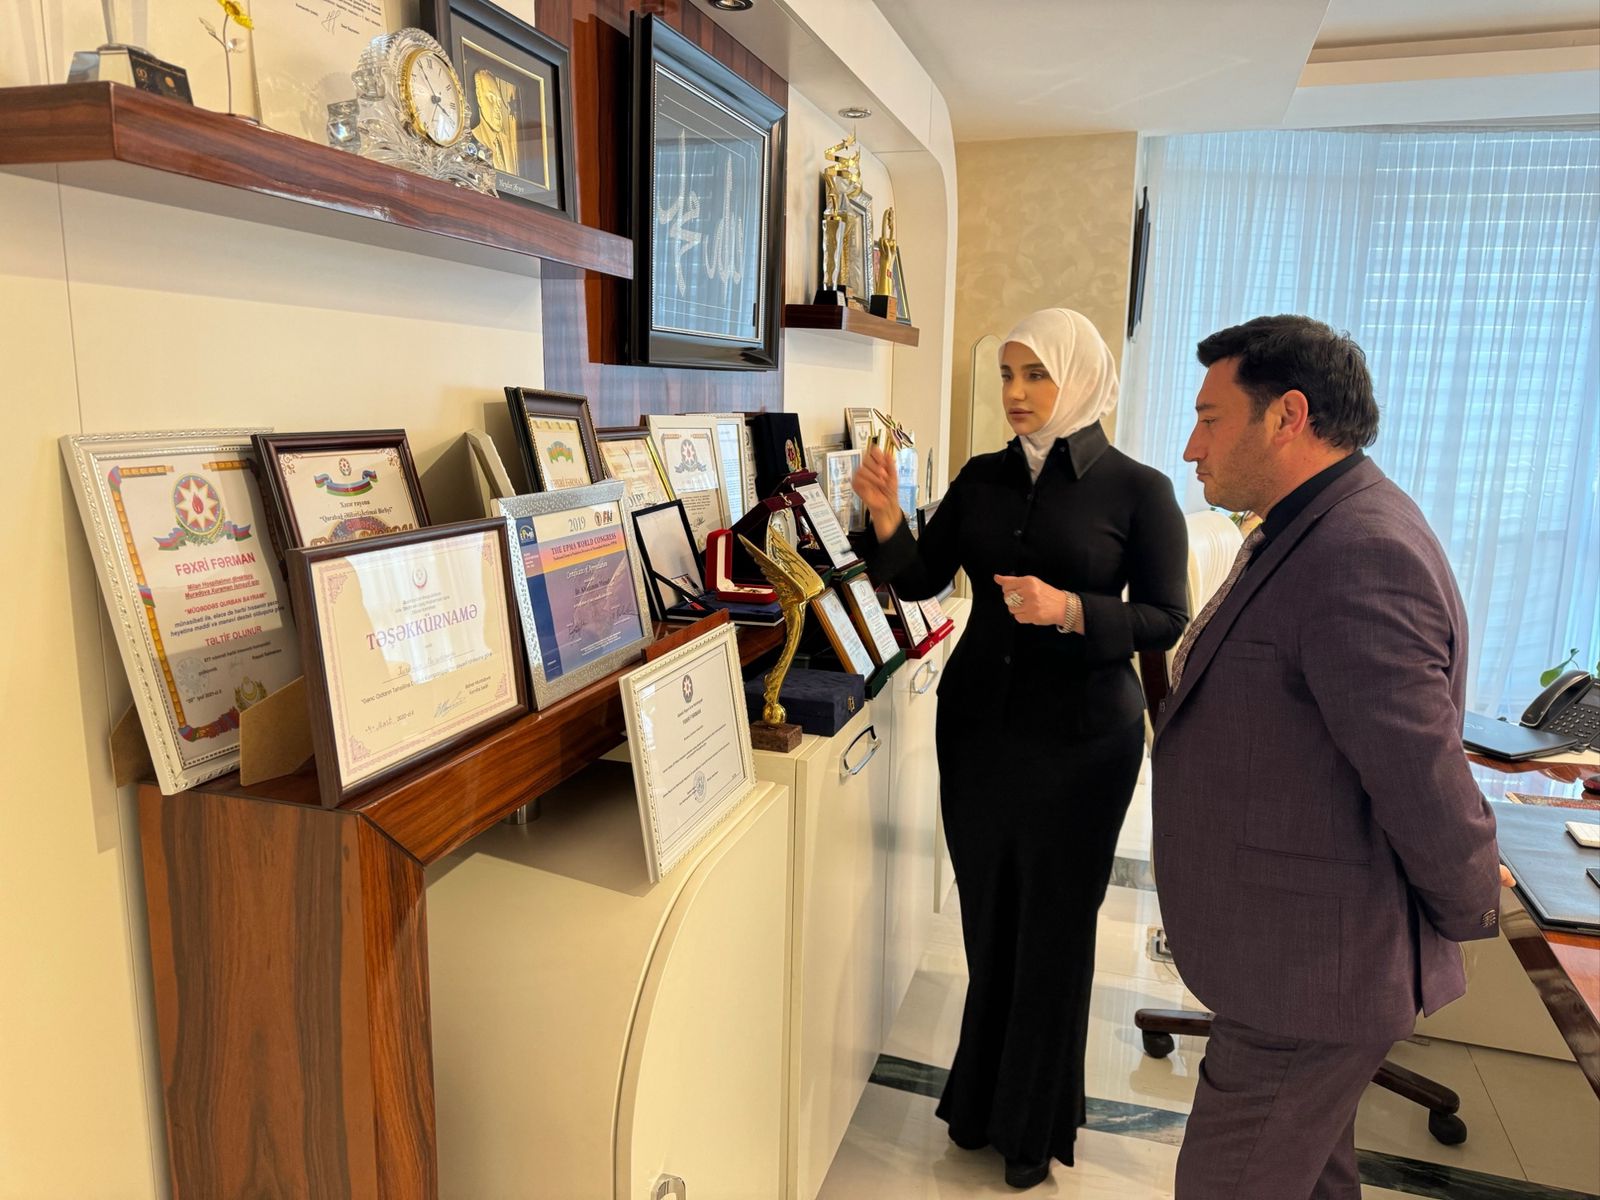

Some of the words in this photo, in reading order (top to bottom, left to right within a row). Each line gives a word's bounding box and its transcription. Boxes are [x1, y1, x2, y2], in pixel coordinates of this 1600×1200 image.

[568, 516, 586, 532] 2019
[551, 545, 562, 555] THE
[577, 538, 594, 549] WORLD
[594, 532, 617, 545] CONGRESS
[175, 557, 210, 576] FƏXRİ
[210, 552, 256, 570] FƏRMAN
[219, 597, 242, 608] QURBAN
[204, 631, 231, 647] TƏLTİF
[232, 625, 263, 640] OLUNUR
[366, 604, 478, 650] TƏŞƏKKÜRNAMƏ
